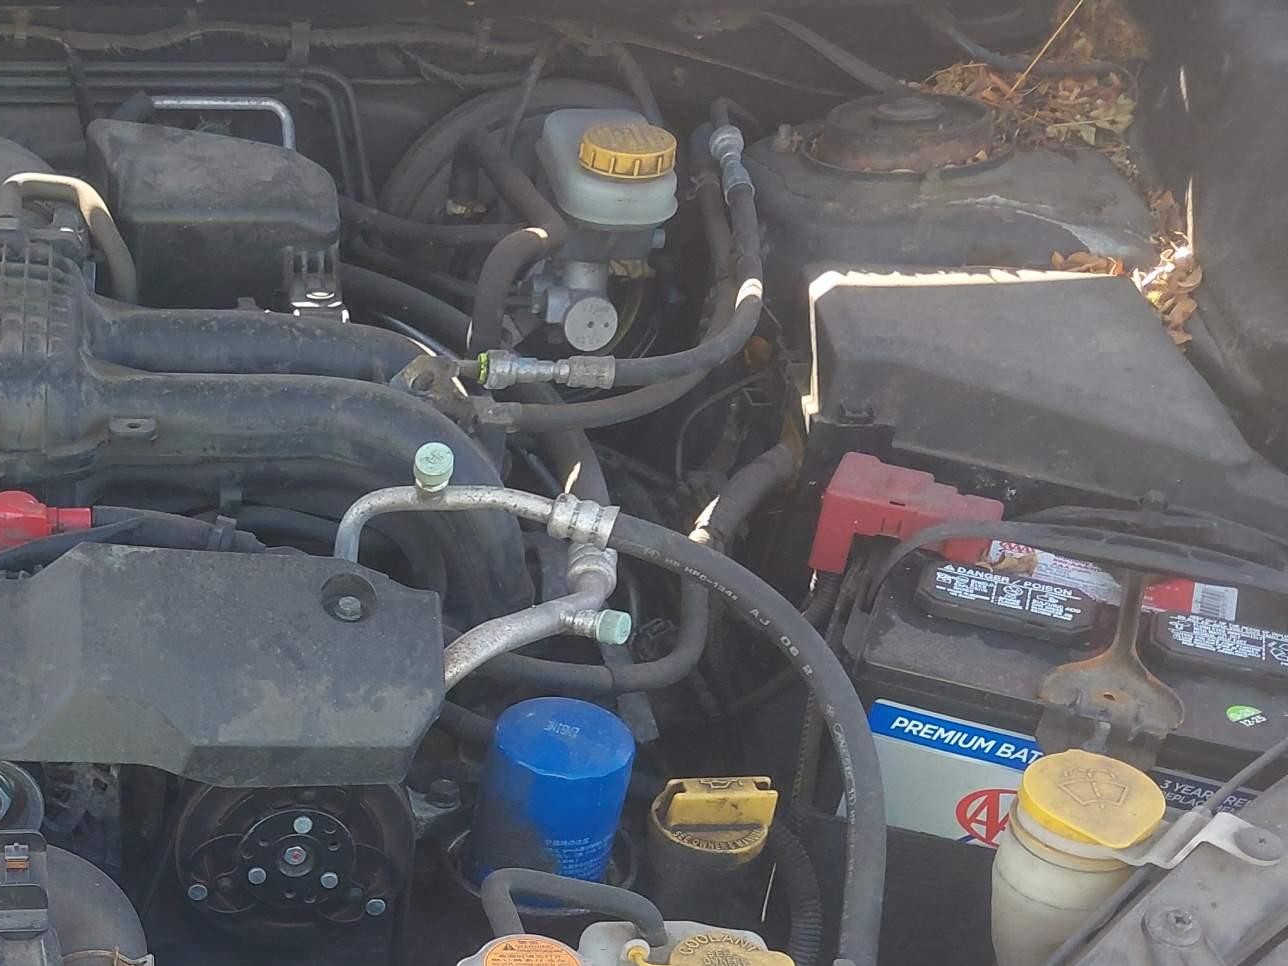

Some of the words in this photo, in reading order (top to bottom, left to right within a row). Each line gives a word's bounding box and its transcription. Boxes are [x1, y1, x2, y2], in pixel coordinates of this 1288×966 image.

[956, 567, 1010, 584] DANGER
[1023, 580, 1073, 597] POISON
[890, 716, 996, 753] PREMIUM
[995, 743, 1045, 764] BAT
[1159, 779, 1172, 790] 3
[1173, 782, 1215, 800] YEAR
[679, 933, 762, 956] COOLANT
